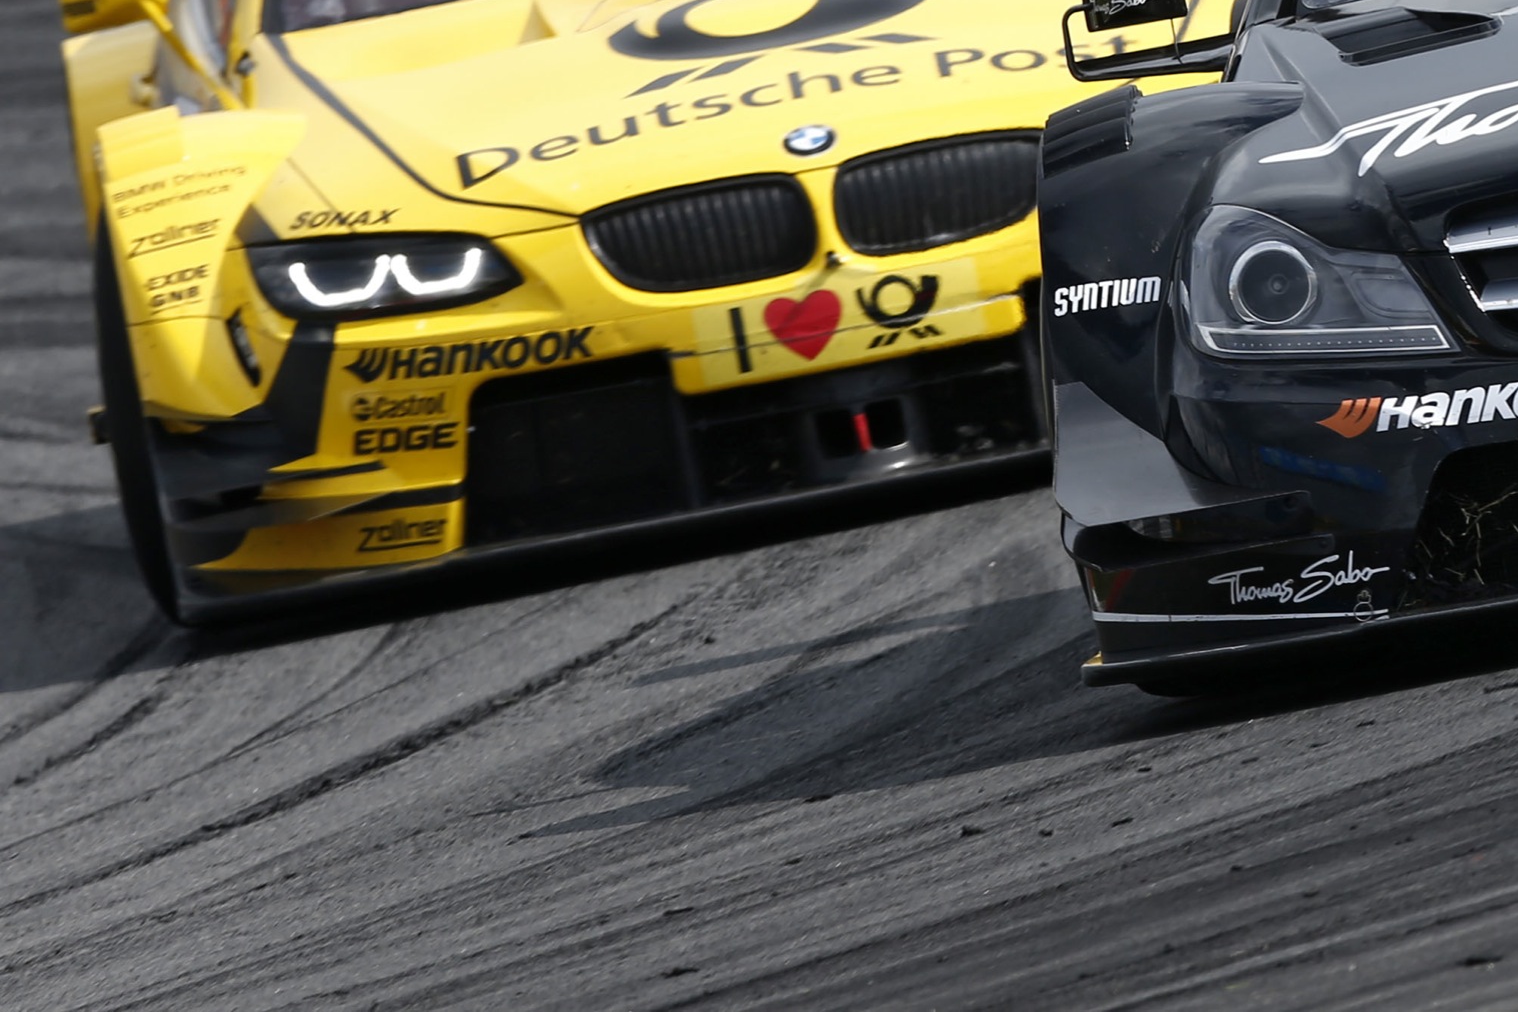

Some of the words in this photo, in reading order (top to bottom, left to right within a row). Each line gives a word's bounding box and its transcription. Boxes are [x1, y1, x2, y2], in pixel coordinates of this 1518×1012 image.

[455, 64, 902, 190] Deutsche
[934, 34, 1138, 78] Post
[288, 207, 402, 230] SONAX
[147, 264, 209, 292] EXIDE
[1054, 276, 1162, 317] SYNTIUM
[729, 307, 753, 375] I
[376, 392, 446, 420] Castrol
[353, 421, 461, 456] EDGE
[1208, 566, 1294, 605] Thomas
[1293, 550, 1391, 603] Sabo
